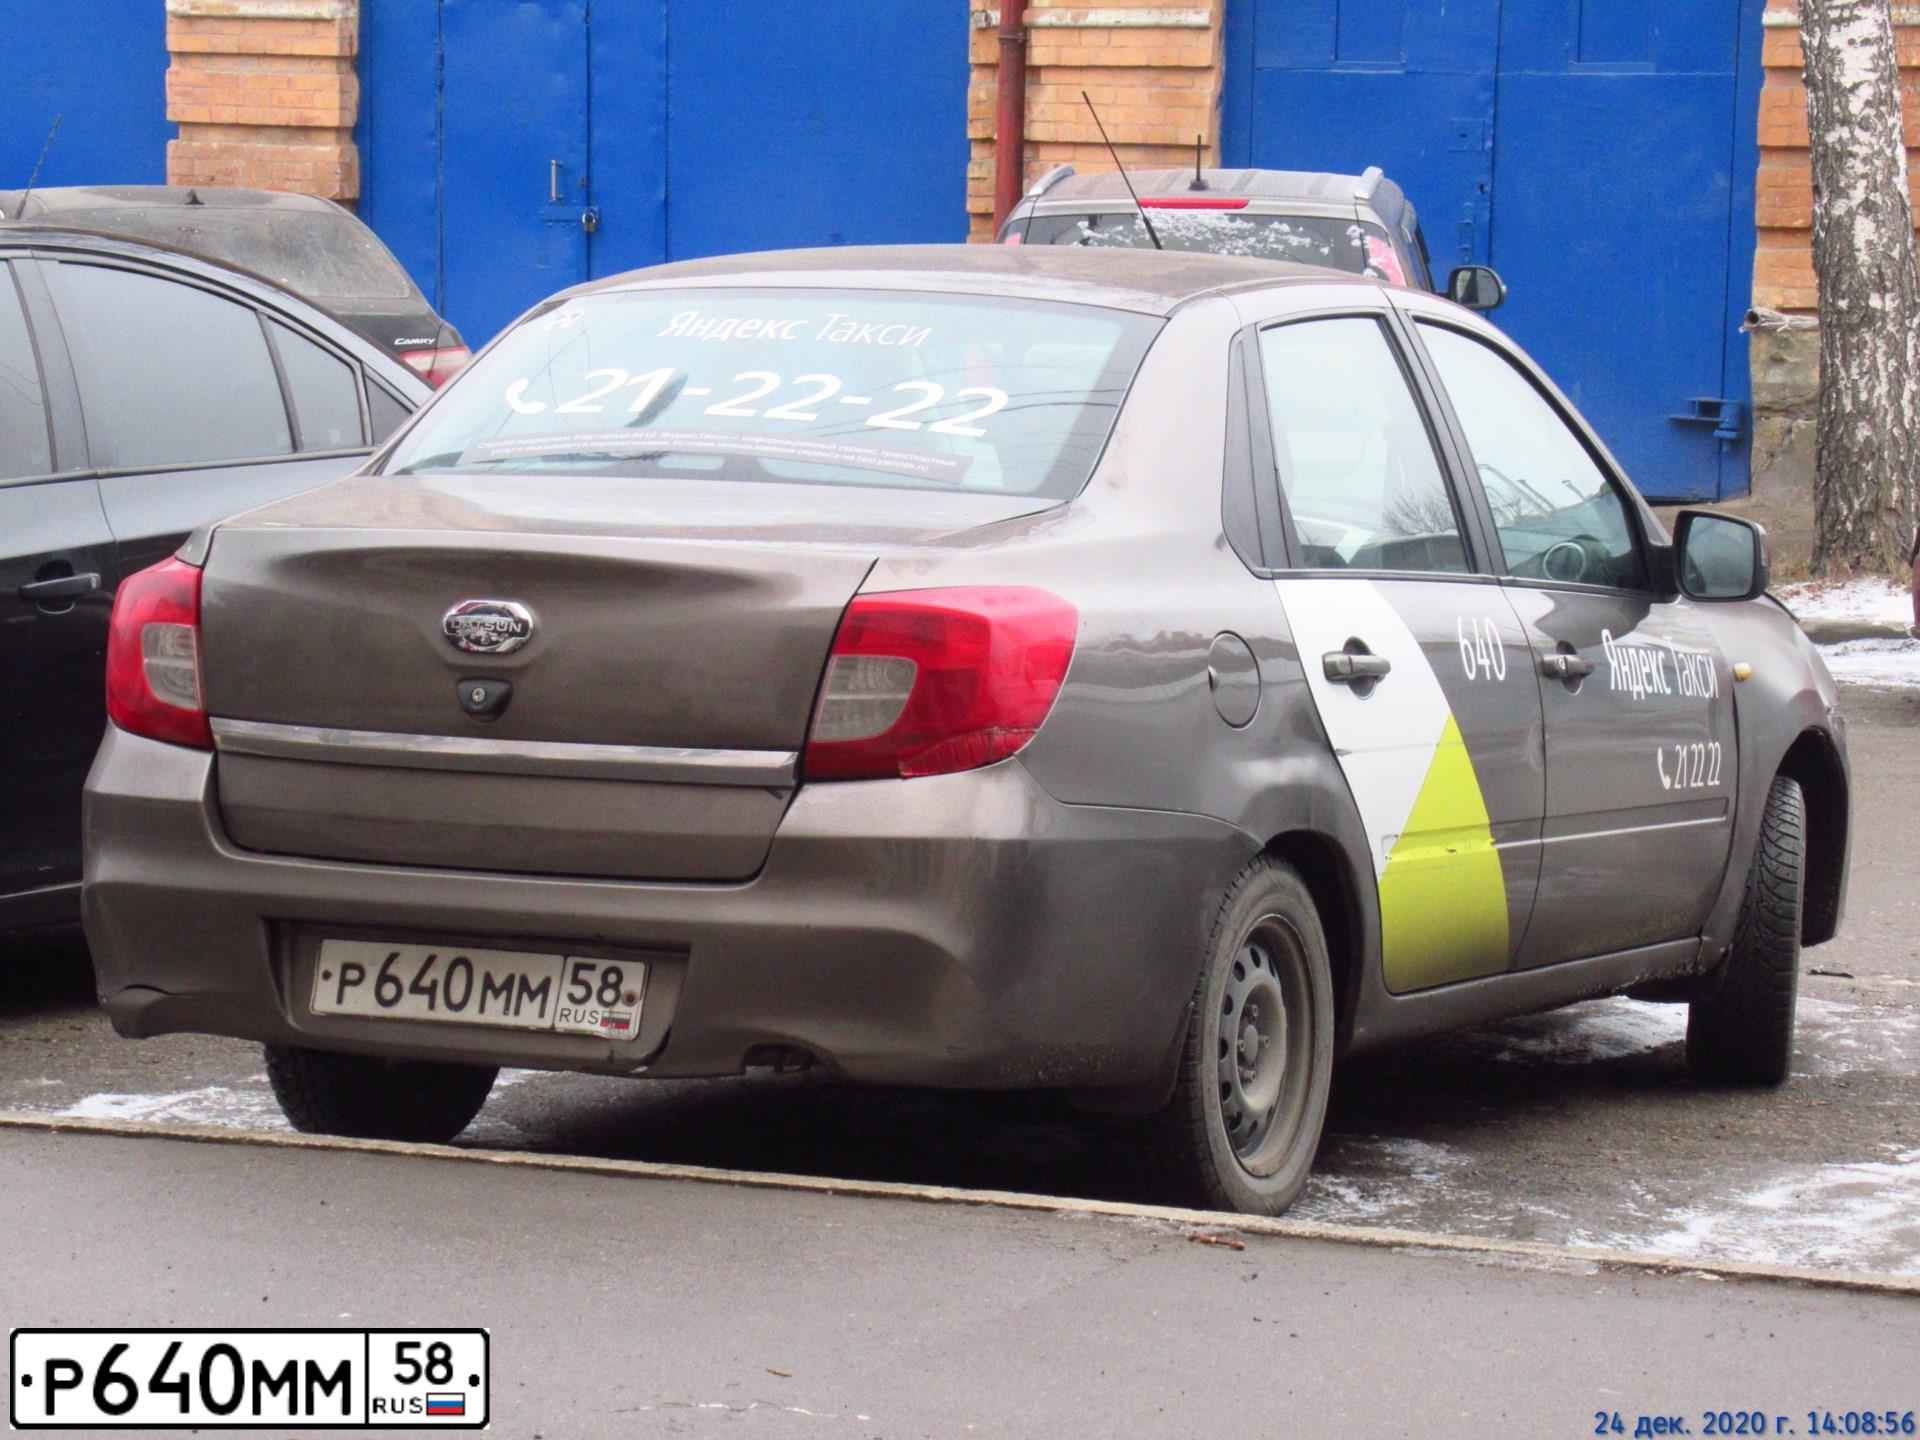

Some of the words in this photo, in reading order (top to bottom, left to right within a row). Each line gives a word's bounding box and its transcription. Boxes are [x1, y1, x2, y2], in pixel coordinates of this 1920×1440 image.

[656, 311, 808, 342] Яндекс
[815, 313, 933, 347] Такси
[553, 367, 1009, 437] 21-22-22
[451, 619, 522, 633] DATSUN
[1457, 616, 1506, 681] 640
[1601, 628, 1672, 700] Яндекс
[1663, 635, 1719, 699] Такси
[566, 962, 624, 1008] 58
[558, 1008, 599, 1025] RUS
